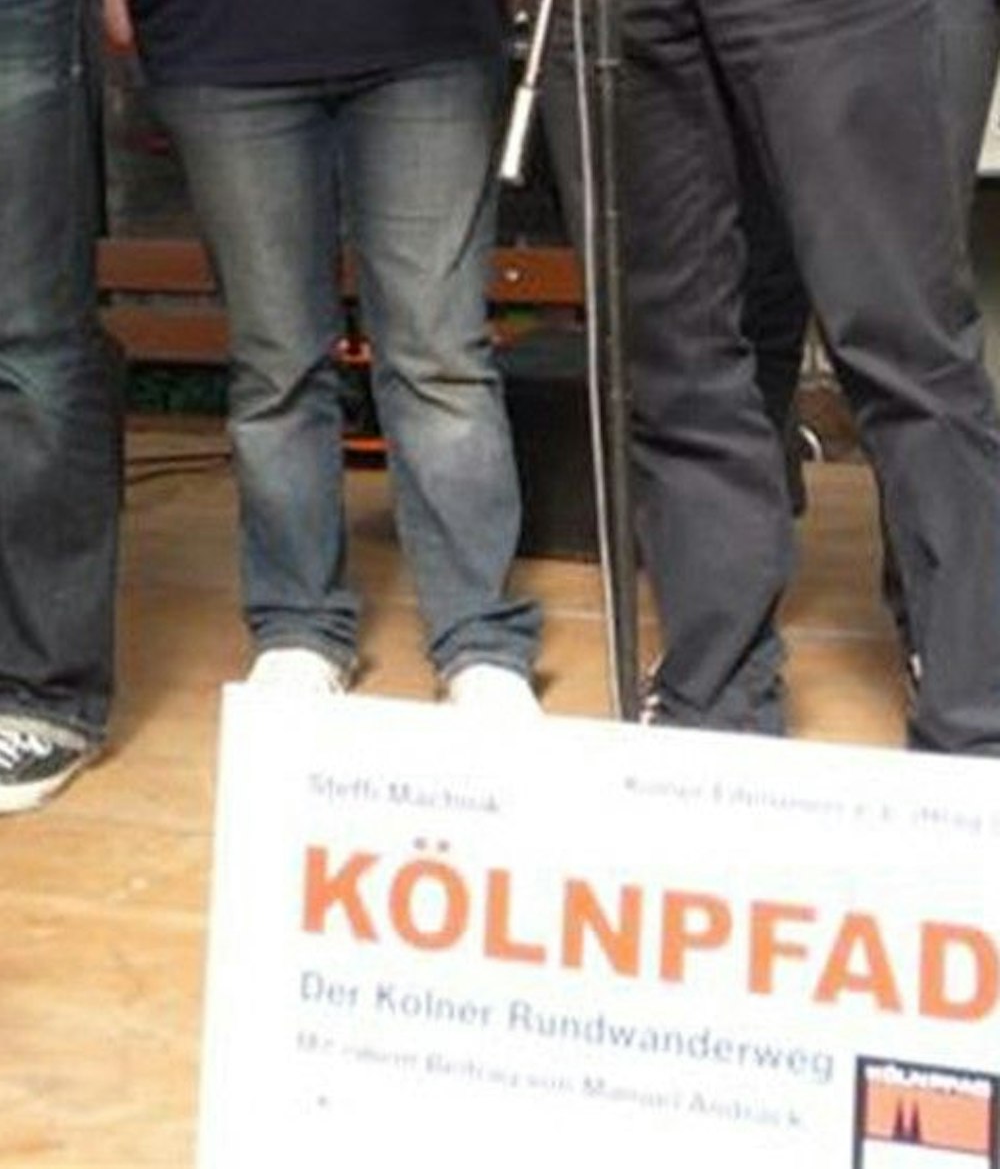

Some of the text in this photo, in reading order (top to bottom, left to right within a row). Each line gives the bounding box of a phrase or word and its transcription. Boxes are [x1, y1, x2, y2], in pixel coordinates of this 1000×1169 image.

[302, 837, 1000, 1024] KÖLNPFAD
[300, 969, 359, 1008] Der
[508, 1001, 835, 1083] Rundwanderweg
